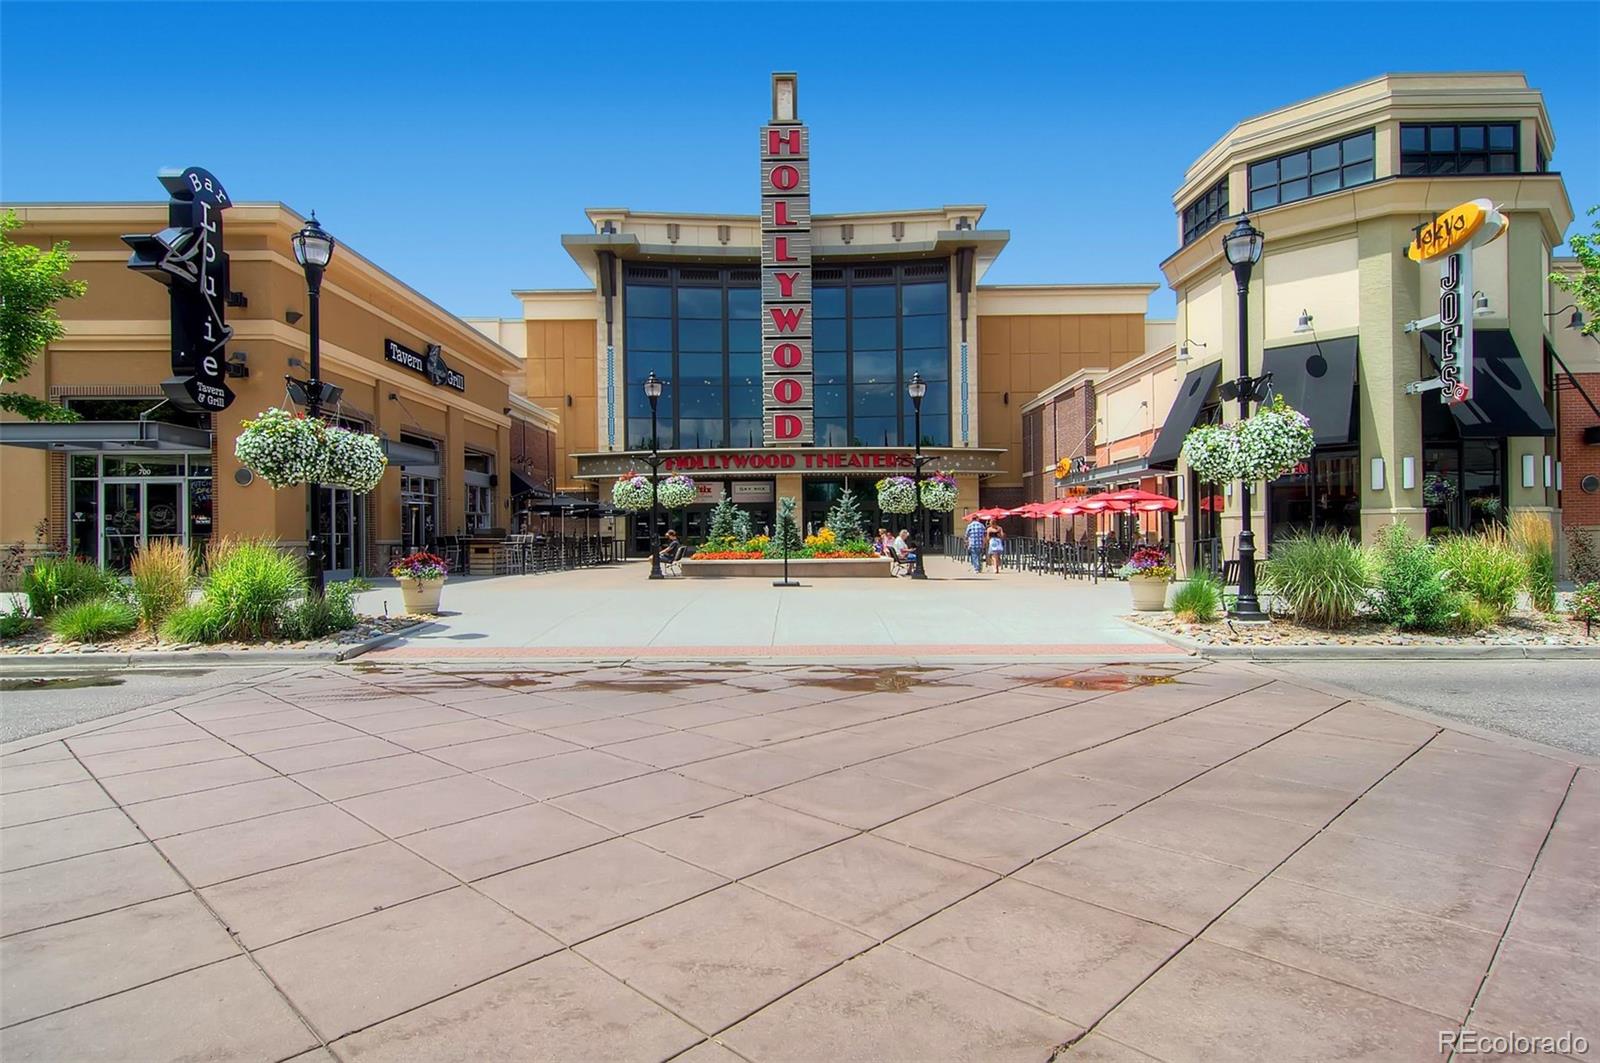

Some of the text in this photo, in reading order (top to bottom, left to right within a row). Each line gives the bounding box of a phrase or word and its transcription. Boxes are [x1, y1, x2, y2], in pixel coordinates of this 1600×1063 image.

[189, 173, 227, 203] Bar
[1412, 212, 1466, 249] Tokyo
[200, 201, 219, 376] Louie
[768, 129, 804, 440] HOLLYWOOD
[1440, 254, 1462, 398] JOE'S
[390, 342, 464, 390] Tavern Grill
[197, 381, 225, 397] Tavern
[207, 395, 225, 408] Grill
[138, 468, 151, 476] 700
[664, 452, 914, 471] HOLLYWOOD THEATERS
